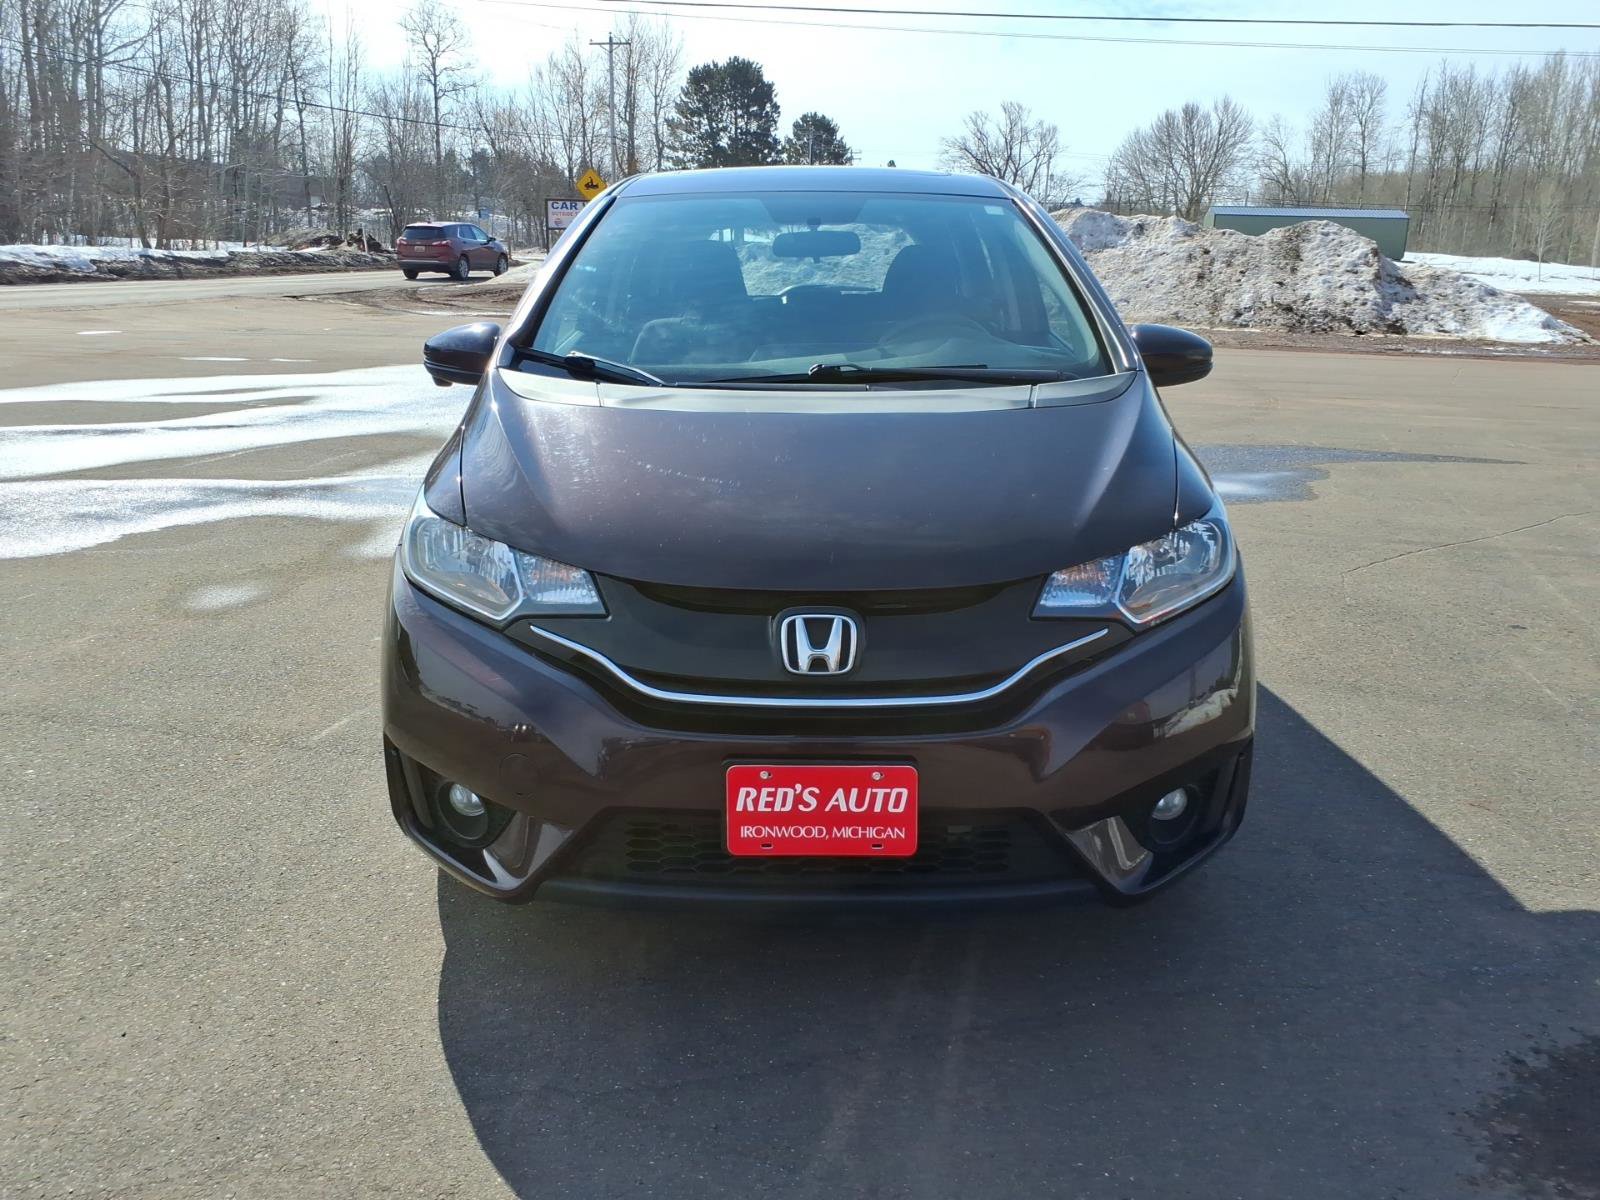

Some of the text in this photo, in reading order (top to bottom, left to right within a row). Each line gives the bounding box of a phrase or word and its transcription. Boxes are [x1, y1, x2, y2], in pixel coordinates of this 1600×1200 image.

[551, 201, 578, 210] CAR
[735, 783, 909, 813] RED'S AUTO
[740, 825, 906, 840] IRONWOOD, MICHIGAN
